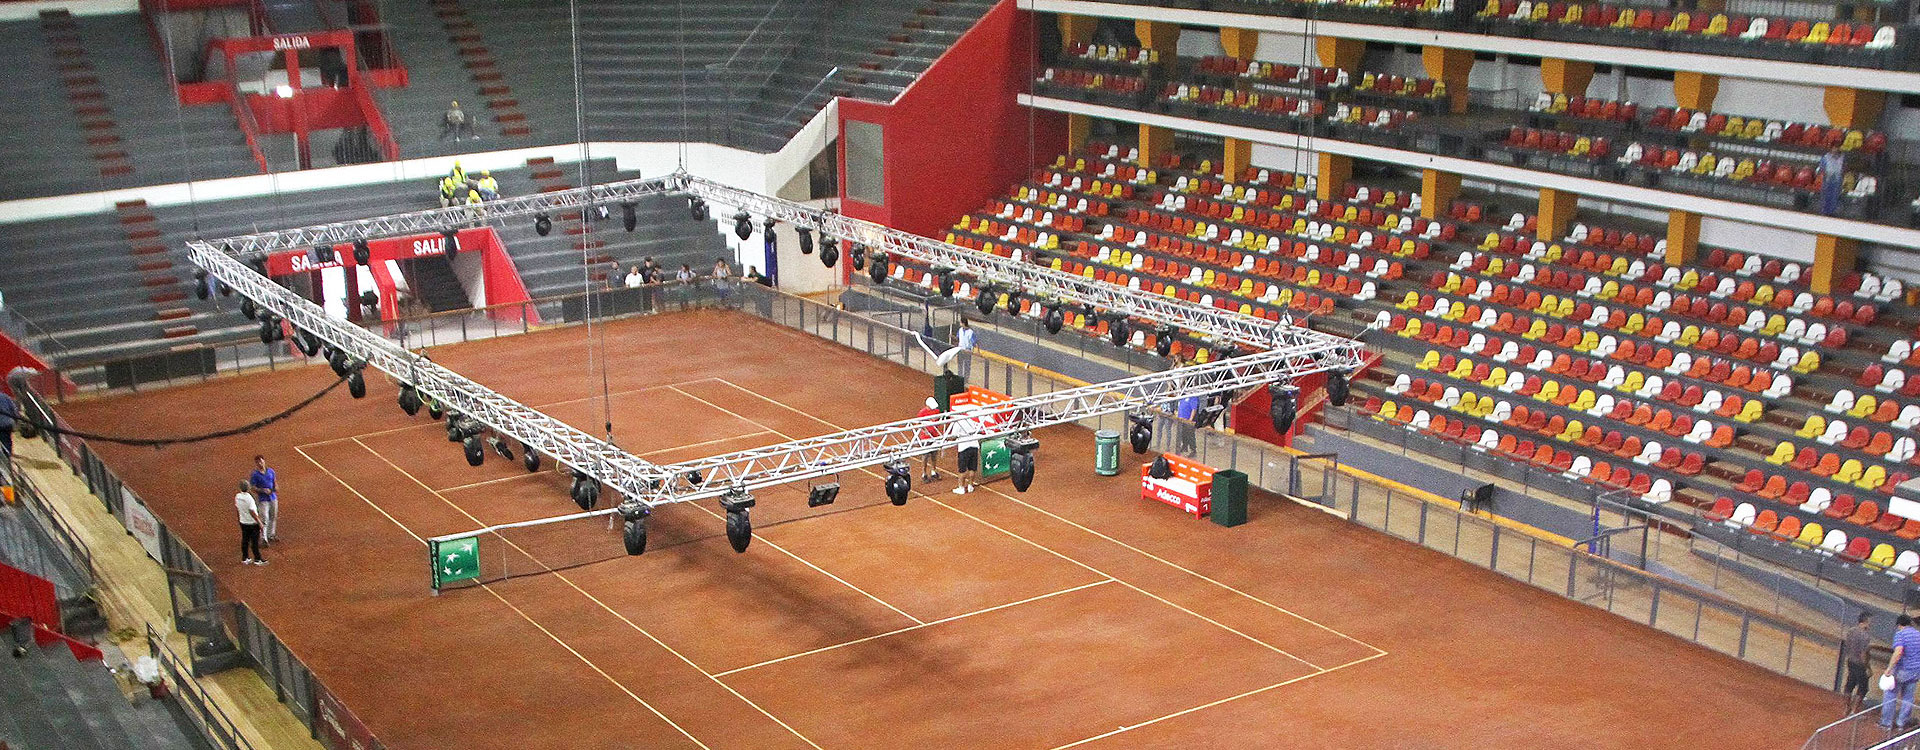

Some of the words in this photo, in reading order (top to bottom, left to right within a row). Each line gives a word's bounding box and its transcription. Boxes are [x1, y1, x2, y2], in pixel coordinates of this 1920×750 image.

[273, 36, 310, 51] SALIDA
[413, 235, 461, 256] SALI
[291, 250, 344, 272] SAA
[1156, 488, 1181, 505] Adecco
